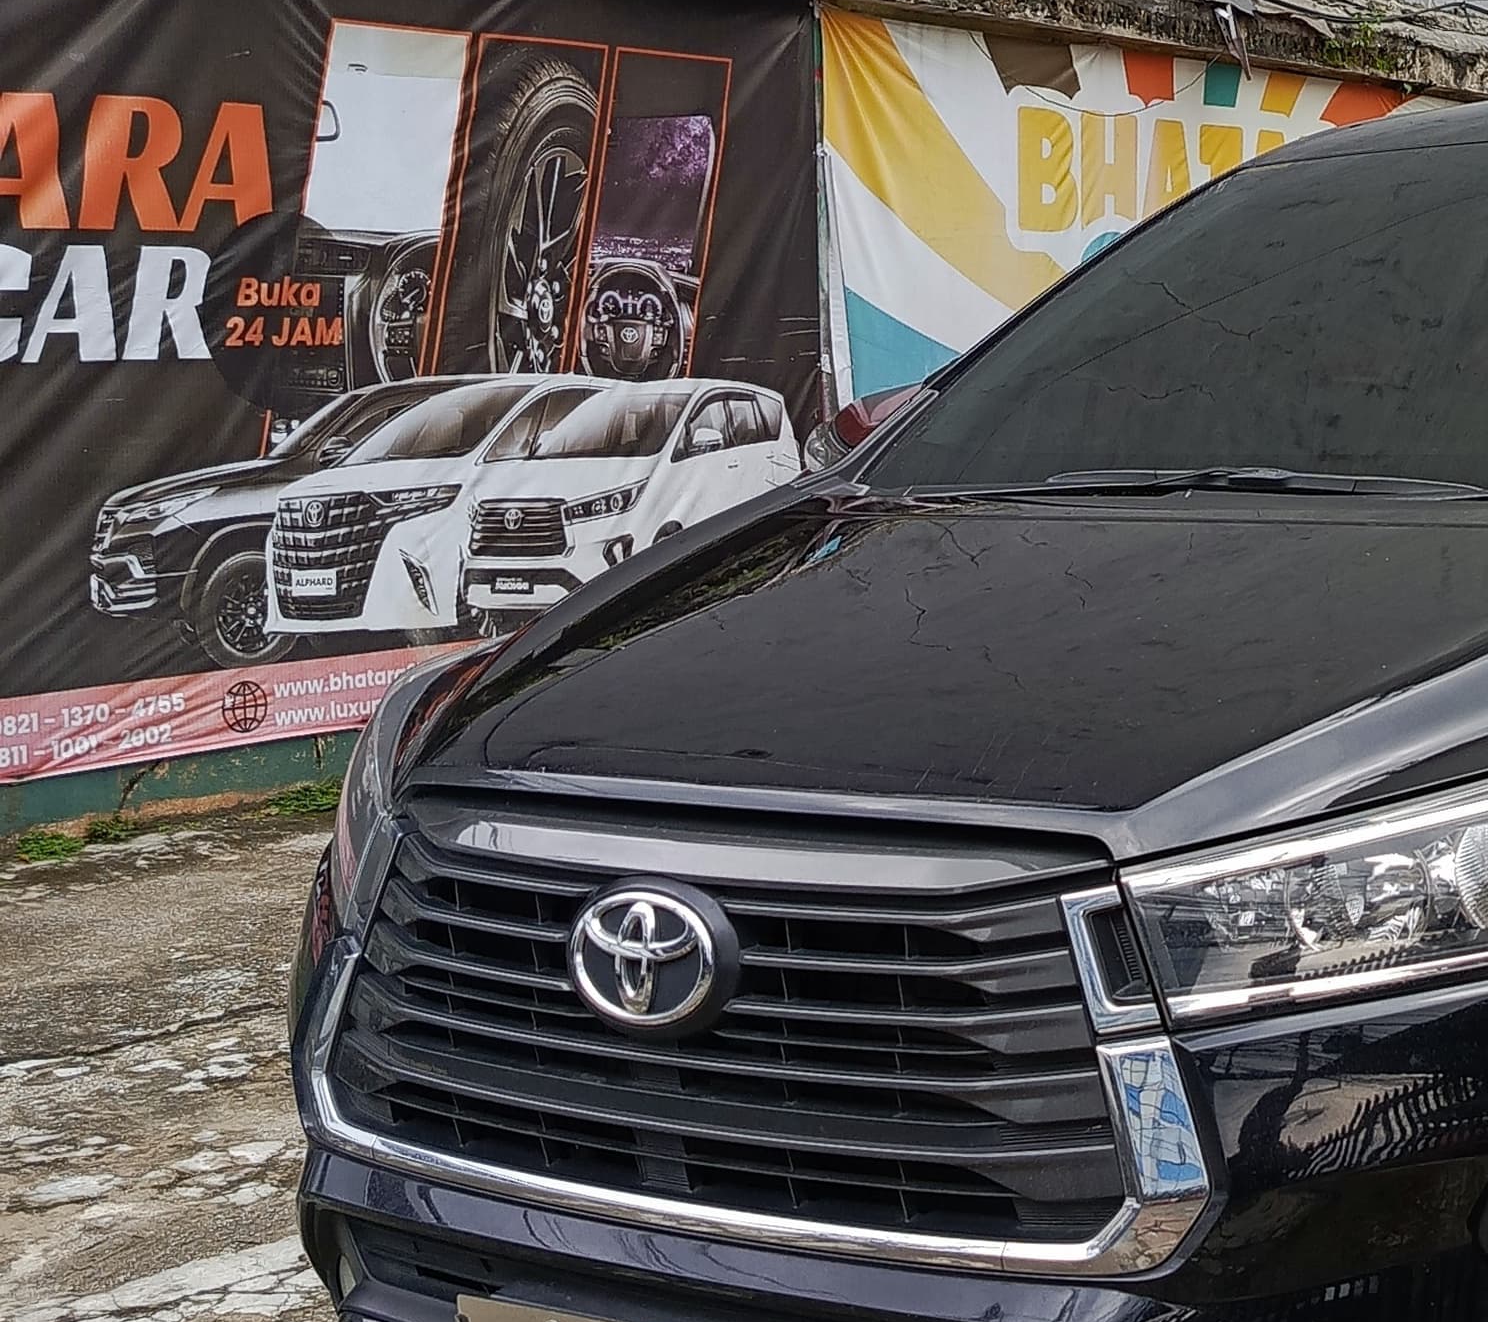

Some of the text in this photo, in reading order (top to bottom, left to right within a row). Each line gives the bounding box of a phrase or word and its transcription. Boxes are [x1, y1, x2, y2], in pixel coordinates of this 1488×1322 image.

[1018, 106, 1285, 233] BHAT
[236, 277, 321, 307] Buka
[225, 317, 343, 346] 24 JAM
[273, 663, 415, 698] www.bhatar
[0, 712, 39, 736] 821
[61, 703, 110, 728] 1370
[131, 693, 187, 718] 4755
